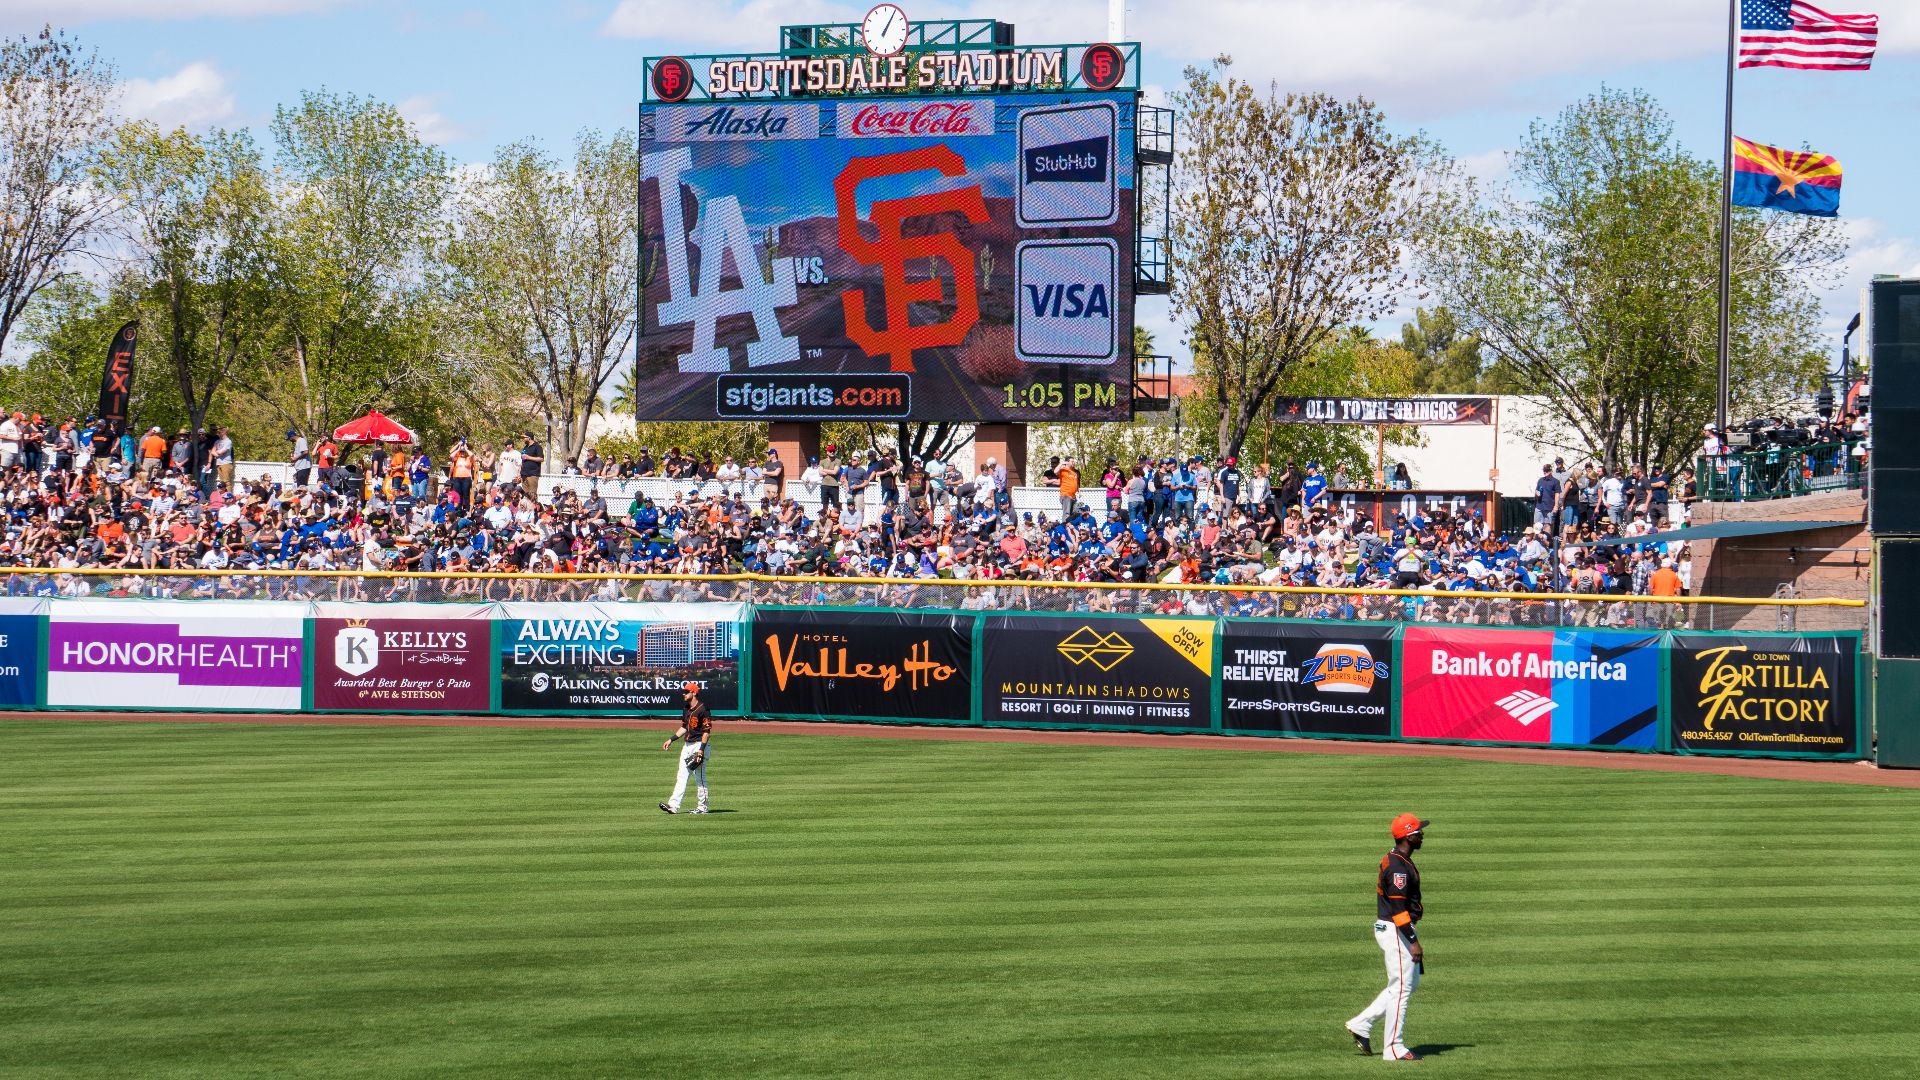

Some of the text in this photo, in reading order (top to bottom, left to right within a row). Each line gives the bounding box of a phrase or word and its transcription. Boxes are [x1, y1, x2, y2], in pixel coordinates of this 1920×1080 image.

[709, 52, 1063, 93] SCOTTSDALE STADIUM
[684, 107, 789, 137] Alaska
[852, 103, 975, 135] Coca-Cola
[1034, 153, 1097, 173] StubHub
[1023, 283, 1109, 319] VISA
[725, 383, 902, 411] sfgiants.com
[1002, 383, 1117, 409] 1:05 PM
[1306, 399, 1458, 421] OLD TOWN GRINGOS
[383, 631, 467, 648] KELLY'S
[518, 619, 620, 641] ALWAYS
[803, 634, 848, 642] HOTEL
[1178, 626, 1204, 648] NOW
[346, 636, 369, 665] K
[514, 644, 625, 665] EXCITING
[1172, 634, 1199, 658] OPEN
[407, 654, 418, 663] at
[765, 634, 957, 692] Valley Ho
[1234, 649, 1287, 665] THIRST
[1431, 649, 1627, 681] Bank of America
[1753, 653, 1767, 661] OLD
[1222, 666, 1299, 682] RELIEVER!
[1300, 654, 1389, 685] ZIPPS
[1326, 672, 1351, 680] SPORTS
[334, 677, 471, 690] Awarded Best Burger & Patio
[1002, 682, 1190, 699] MOUNTAIN SHADOWS
[371, 690, 390, 699] AVE
[391, 690, 400, 699] &
[401, 690, 446, 699] STETSON
[569, 695, 670, 704] 101 & TALKING STICK WAY
[1001, 702, 1190, 717] RESORT GOLF DINING FITNESS
[1681, 731, 1844, 745] 480.945.4567 OldTownTortillaFactory.com
